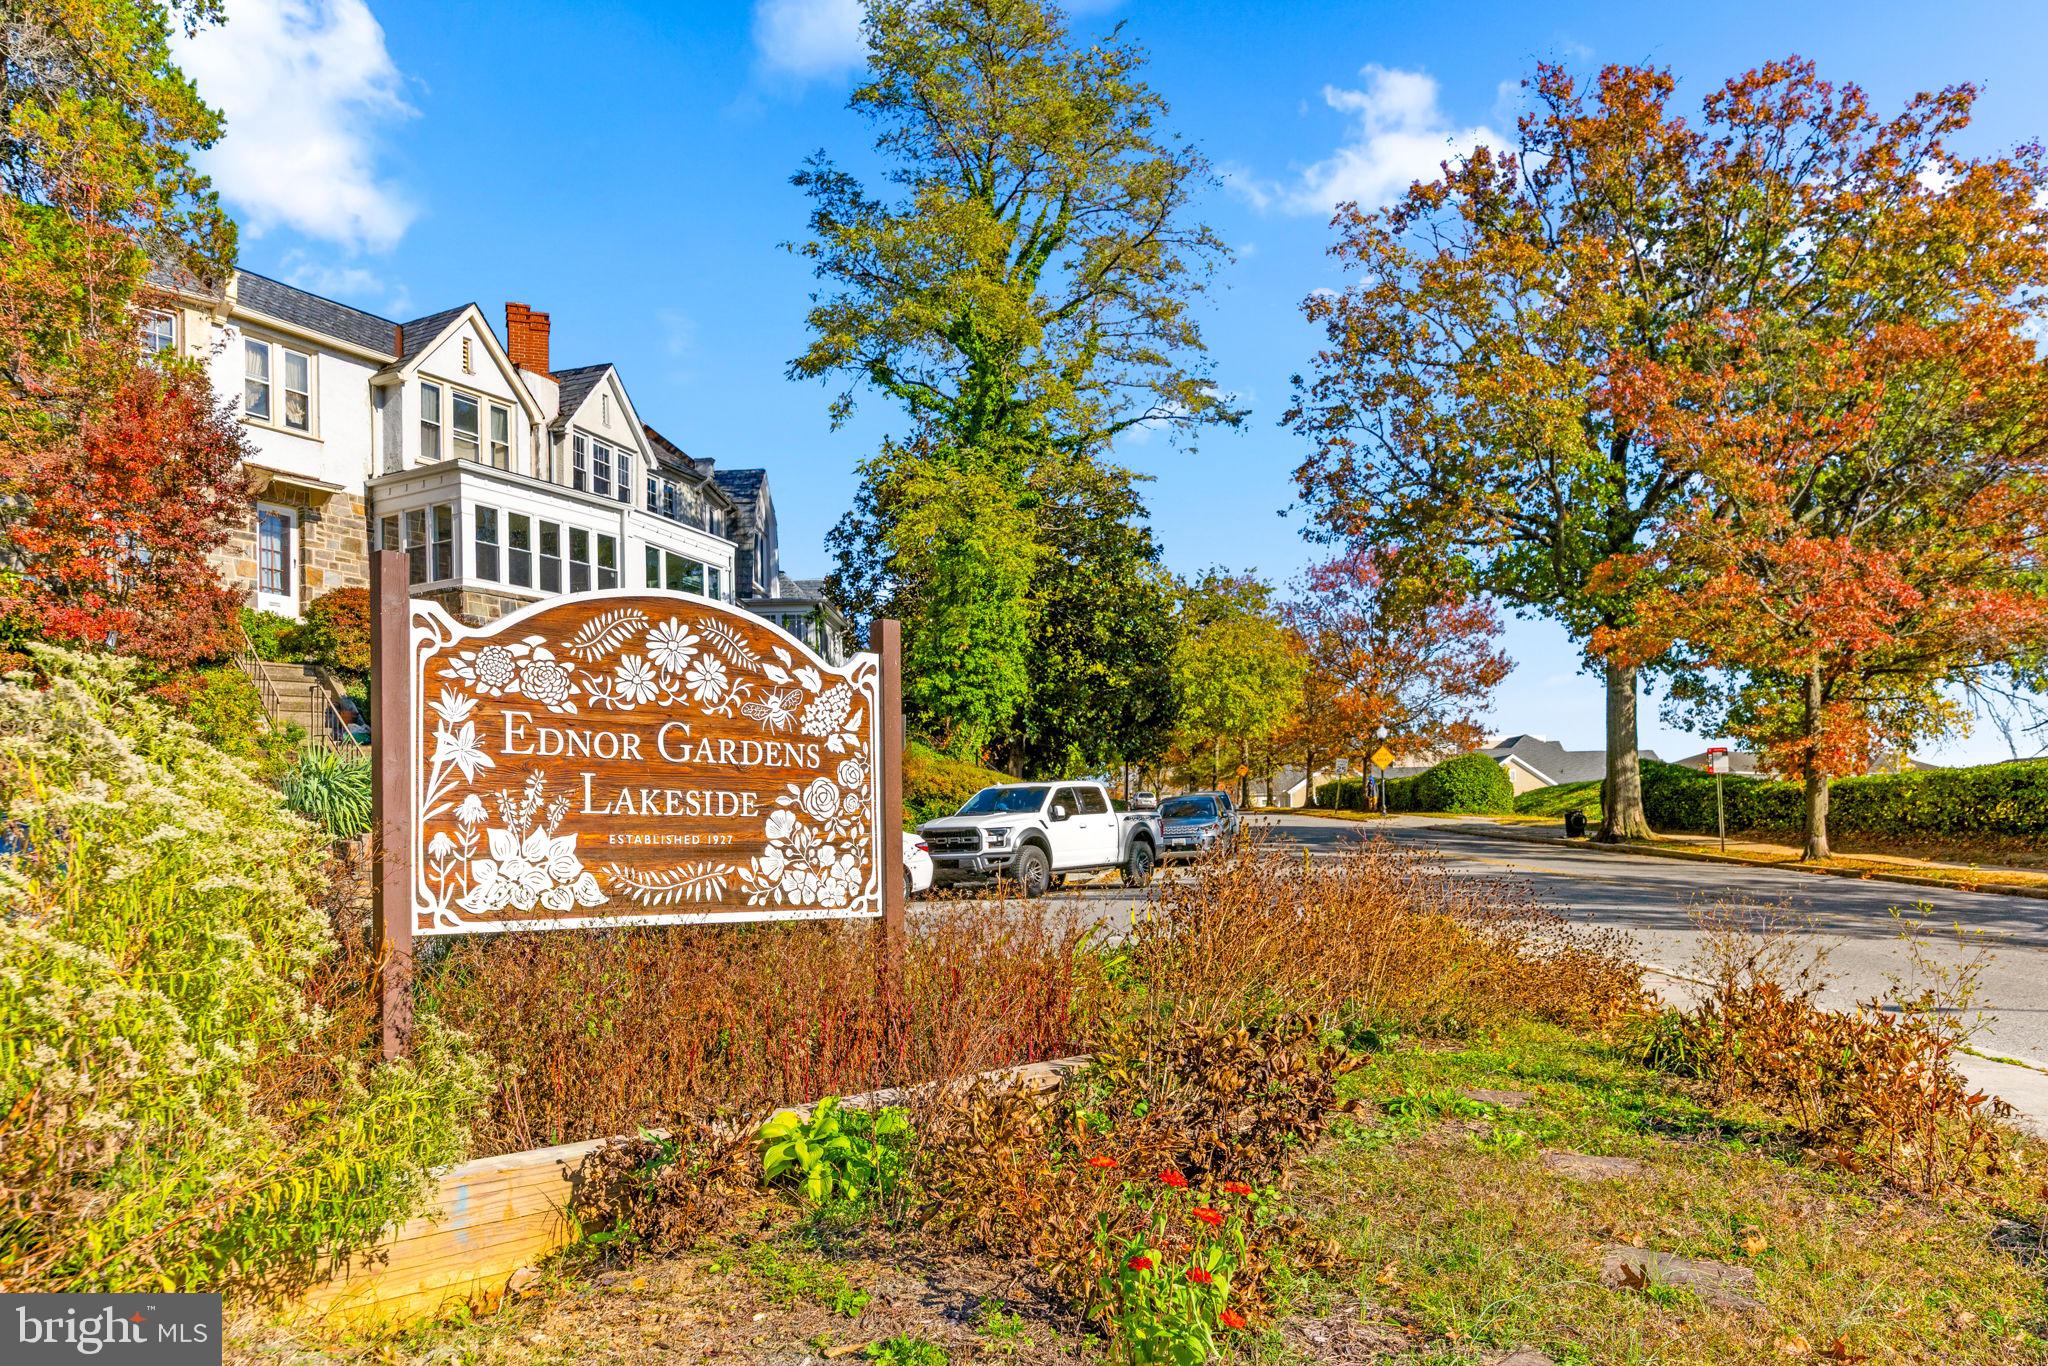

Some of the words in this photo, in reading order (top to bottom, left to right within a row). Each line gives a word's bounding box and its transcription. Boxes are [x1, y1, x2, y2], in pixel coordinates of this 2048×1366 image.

[500, 710, 644, 761] EDNOR
[657, 721, 821, 769] GARDENS
[579, 772, 760, 817] LAKESIDE
[608, 834, 701, 845] ESTABLISHED
[707, 835, 733, 845] 1927
